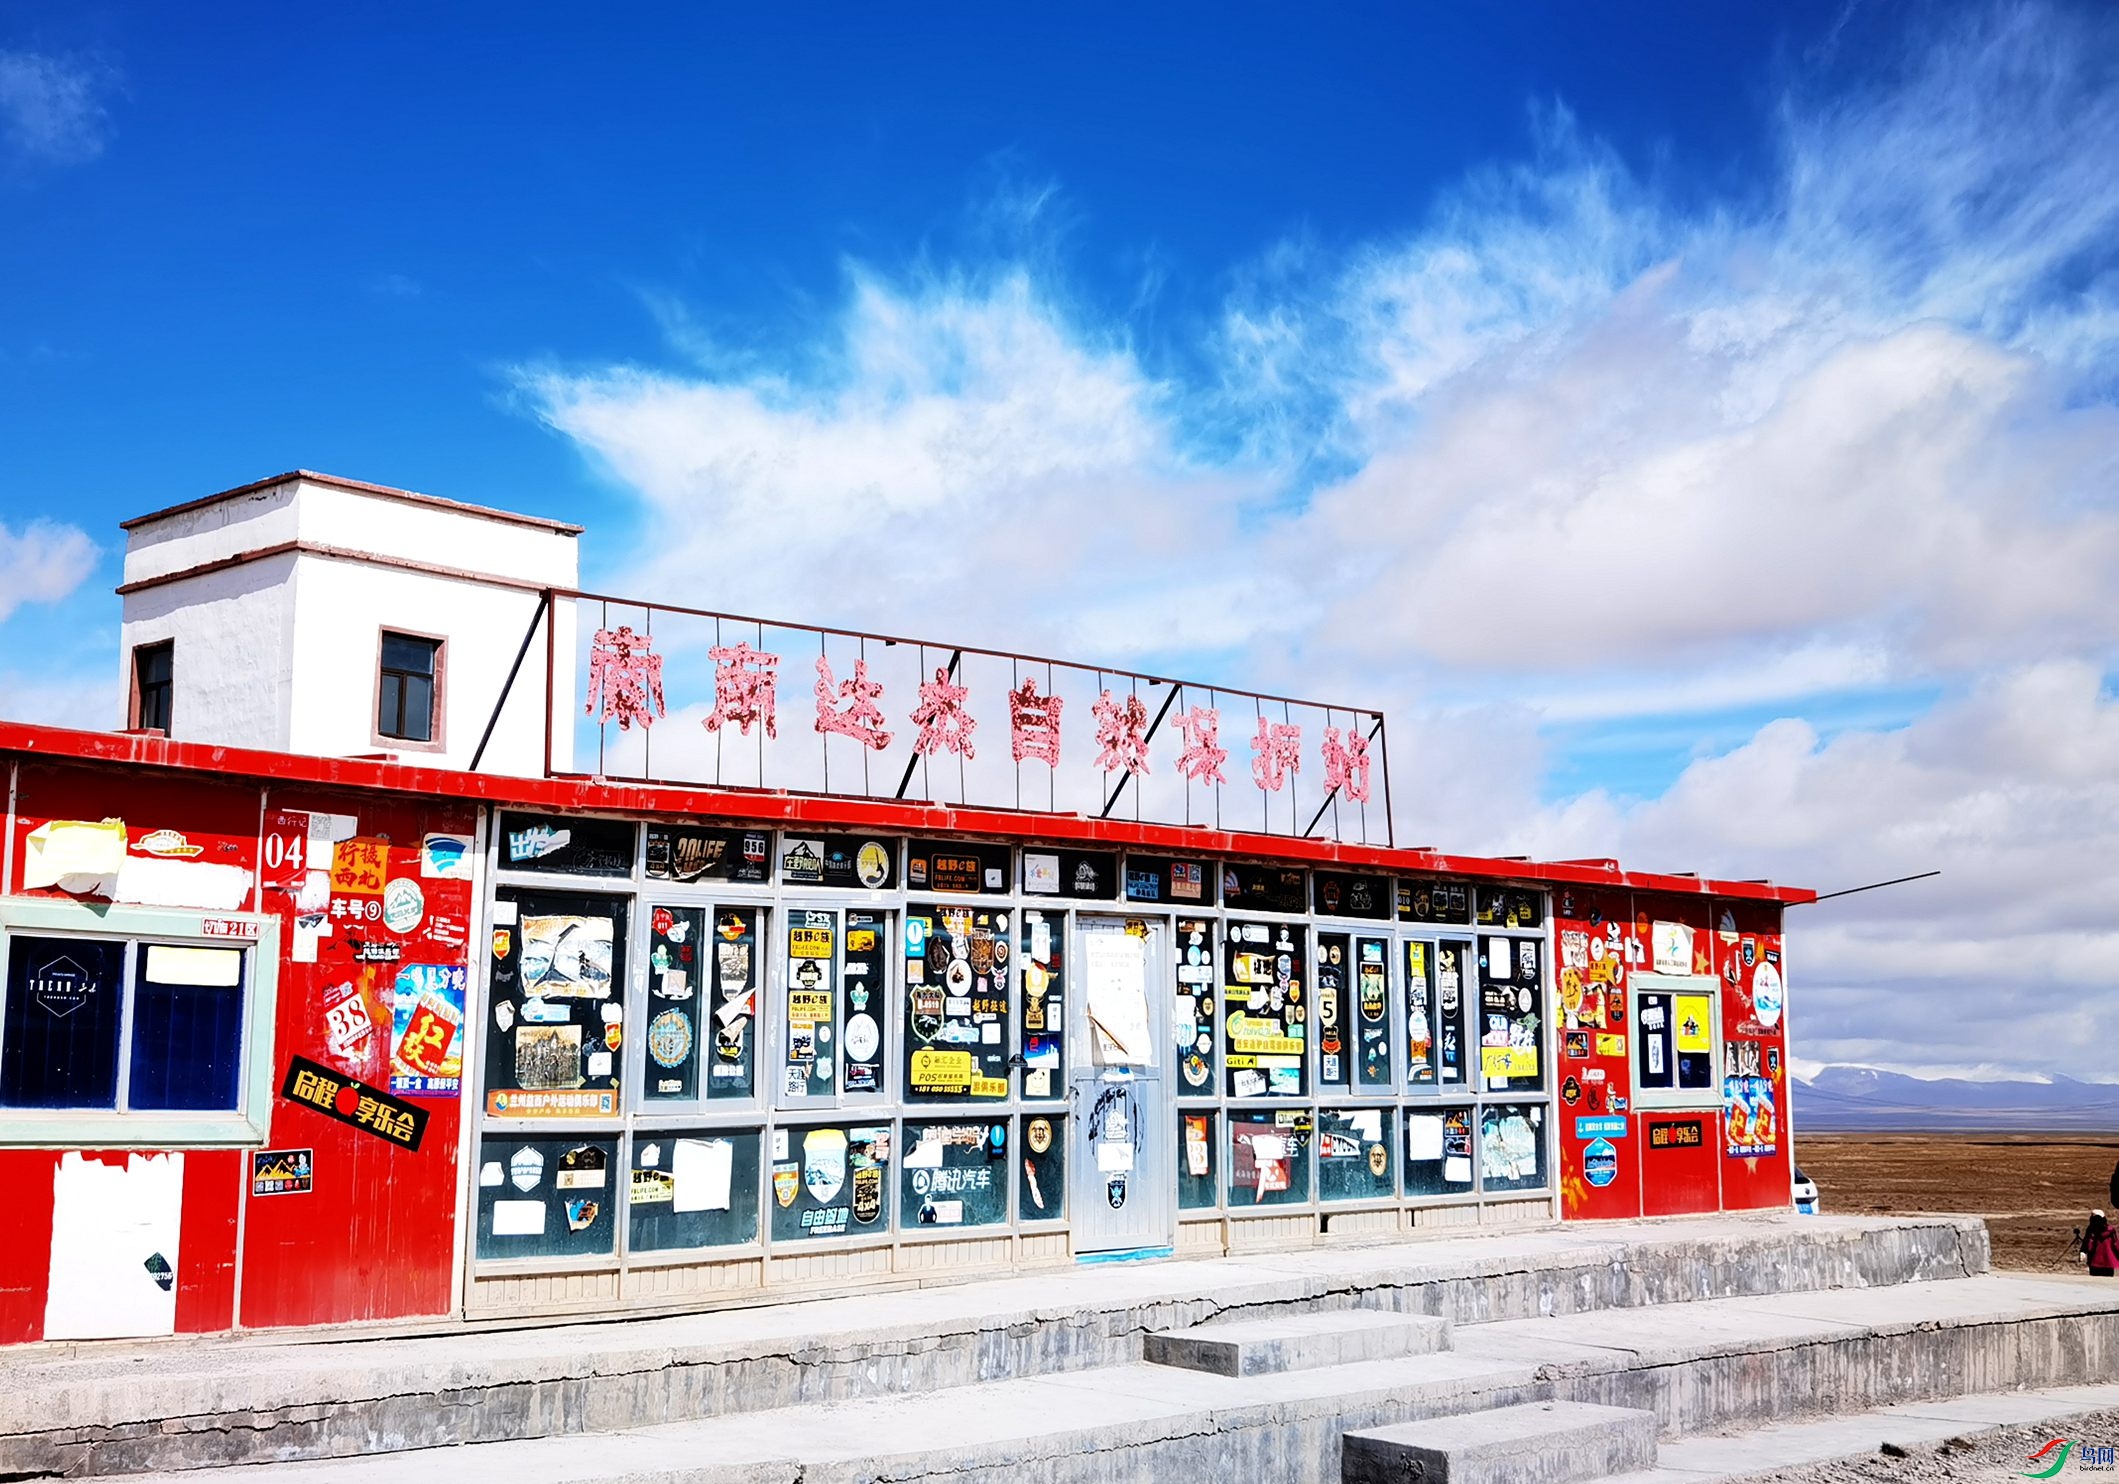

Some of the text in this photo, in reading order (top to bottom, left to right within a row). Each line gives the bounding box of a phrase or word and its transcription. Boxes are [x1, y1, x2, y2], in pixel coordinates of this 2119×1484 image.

[265, 833, 304, 869] 04
[338, 842, 382, 867] 行摄
[744, 840, 764, 854] 956
[334, 869, 381, 890] 西北
[332, 999, 367, 1037] 38
[1323, 1001, 1334, 1018] 5
[1226, 1057, 1244, 1065] Giti
[918, 1073, 938, 1082] POS
[292, 1069, 415, 1142] 启程 享乐会
[930, 1168, 992, 1192] 腾讯汽车
